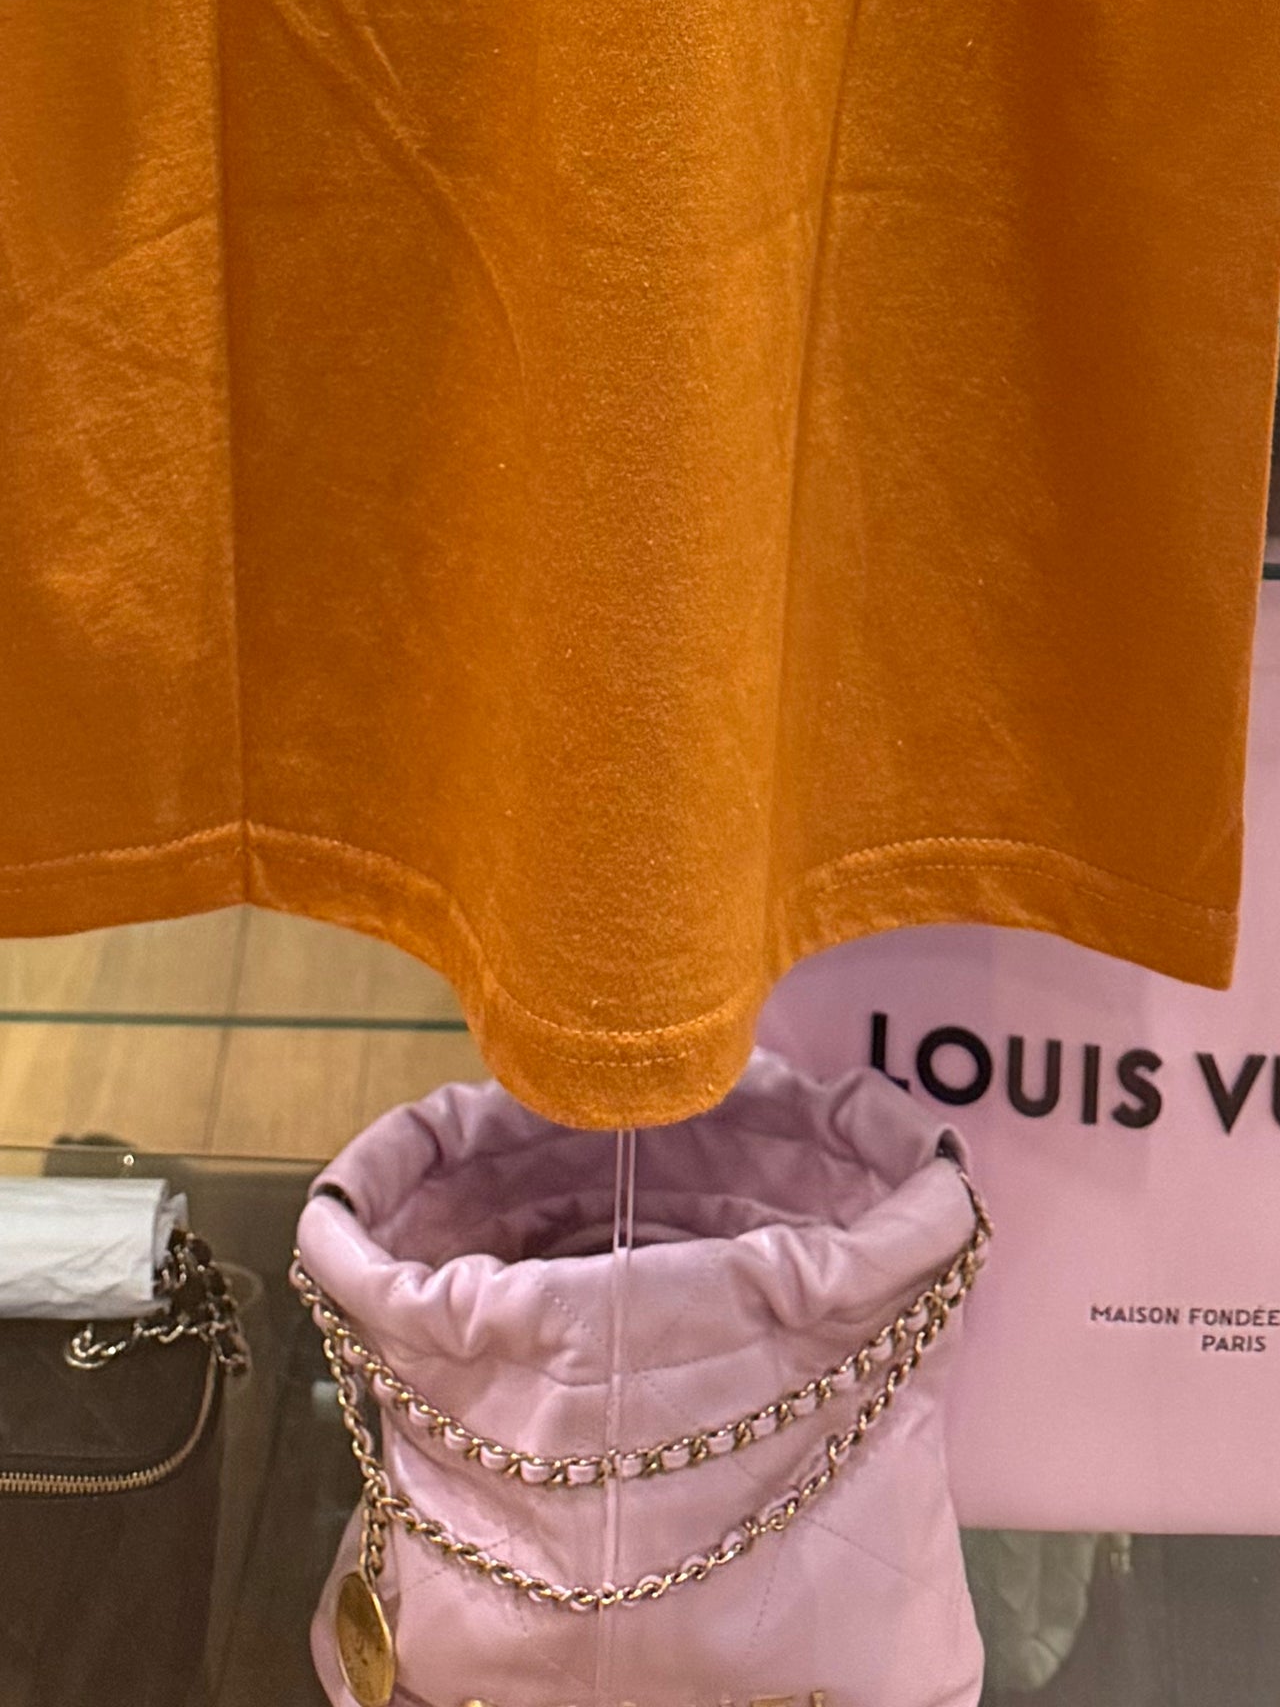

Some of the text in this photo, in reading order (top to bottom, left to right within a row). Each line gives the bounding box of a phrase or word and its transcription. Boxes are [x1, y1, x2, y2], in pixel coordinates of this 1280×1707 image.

[869, 1011, 1163, 1129] LOUIS
[1090, 1304, 1180, 1325] MAISON
[1201, 1334, 1267, 1353] PARIS
